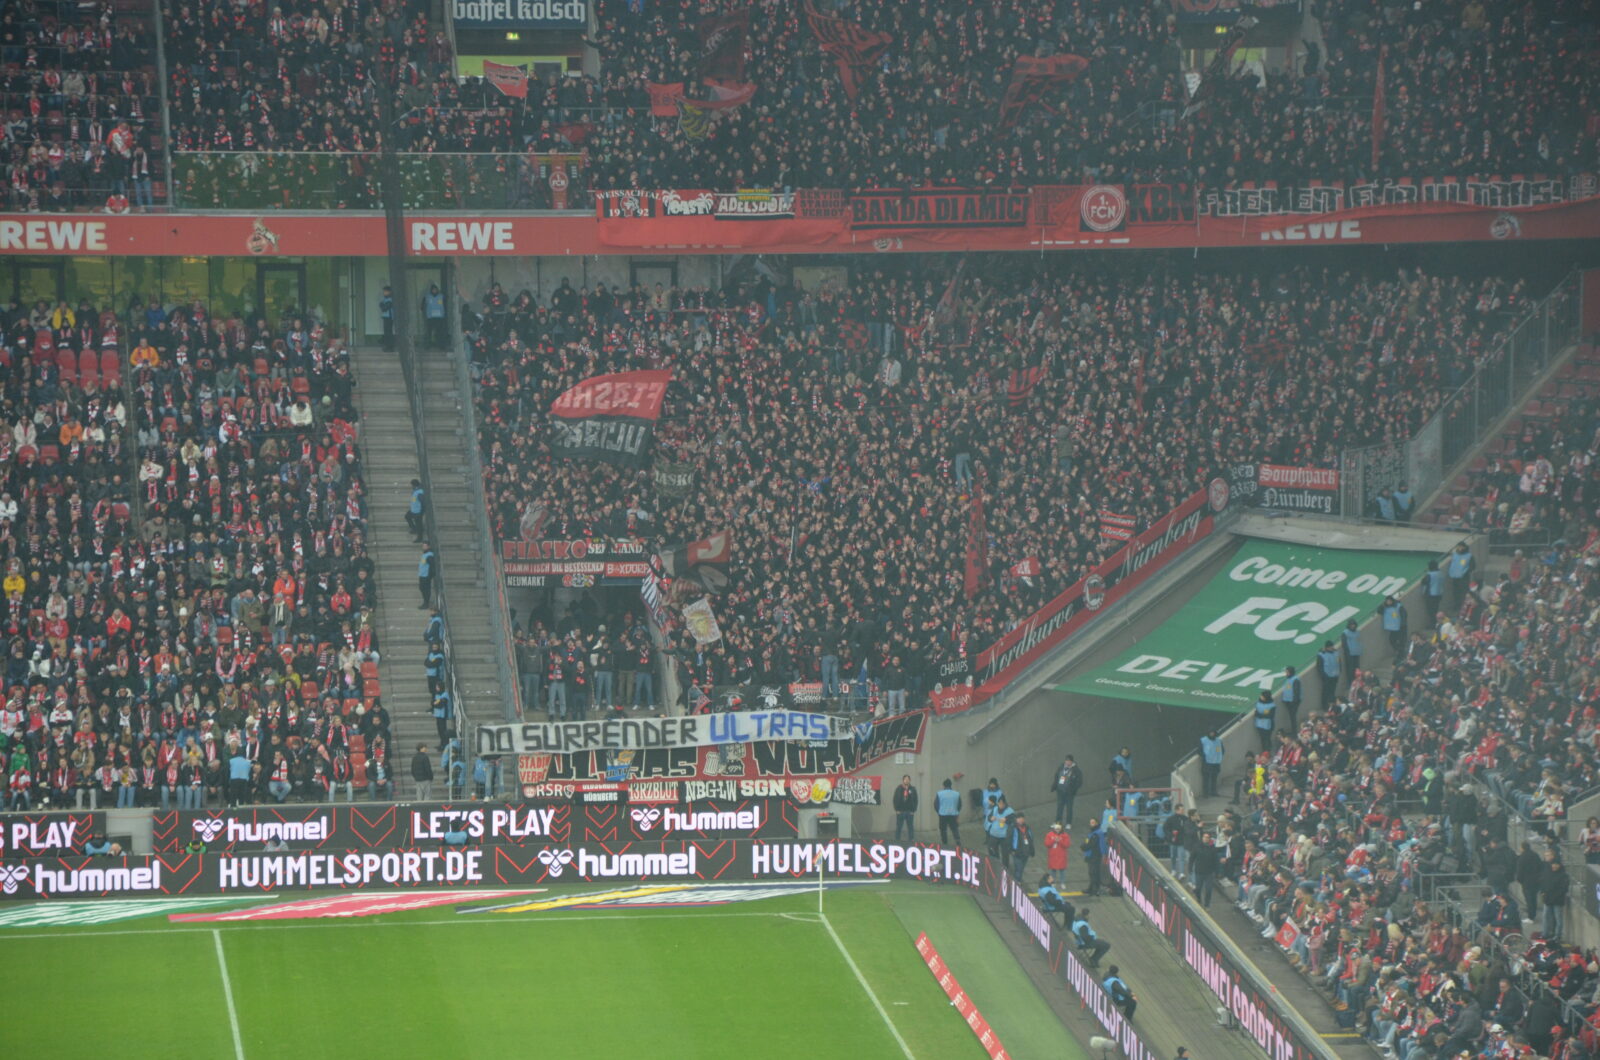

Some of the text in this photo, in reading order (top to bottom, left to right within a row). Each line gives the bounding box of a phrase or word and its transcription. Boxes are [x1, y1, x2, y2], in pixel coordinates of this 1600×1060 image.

[852, 198, 931, 222] BANDA
[935, 198, 958, 222] DI
[962, 195, 1029, 221] AMICI
[1090, 206, 1116, 218] FCN
[1129, 186, 1193, 222] KBN
[0, 221, 107, 250] REWE
[412, 222, 515, 250] REWE
[1260, 488, 1332, 513] Nürnberg
[503, 540, 586, 559] FIASKO
[507, 576, 546, 587] NEUMARKT
[1229, 556, 1348, 591] Come
[980, 510, 1201, 686] Nordkurve Nürnberg
[1203, 596, 1361, 645] FC!
[940, 660, 969, 677] CHAMPS
[1115, 654, 1287, 690] DEVK
[477, 727, 514, 753] NO
[522, 718, 698, 751] SURRENDER
[710, 712, 836, 743] ULTRAS!
[537, 784, 563, 797] RSR
[583, 791, 618, 802] NÜRNBERG
[684, 779, 738, 803] NBG-LW
[740, 779, 787, 797] SGN
[227, 815, 328, 842] hummel
[492, 809, 555, 837] PLAY
[664, 806, 760, 832] hummel
[12, 821, 76, 850] PLAY
[220, 850, 483, 888] HUMMELSPORT.DE
[579, 845, 697, 877] hummel
[752, 843, 981, 886] HUMMELSPORT.DE
[35, 859, 161, 893] hummel
